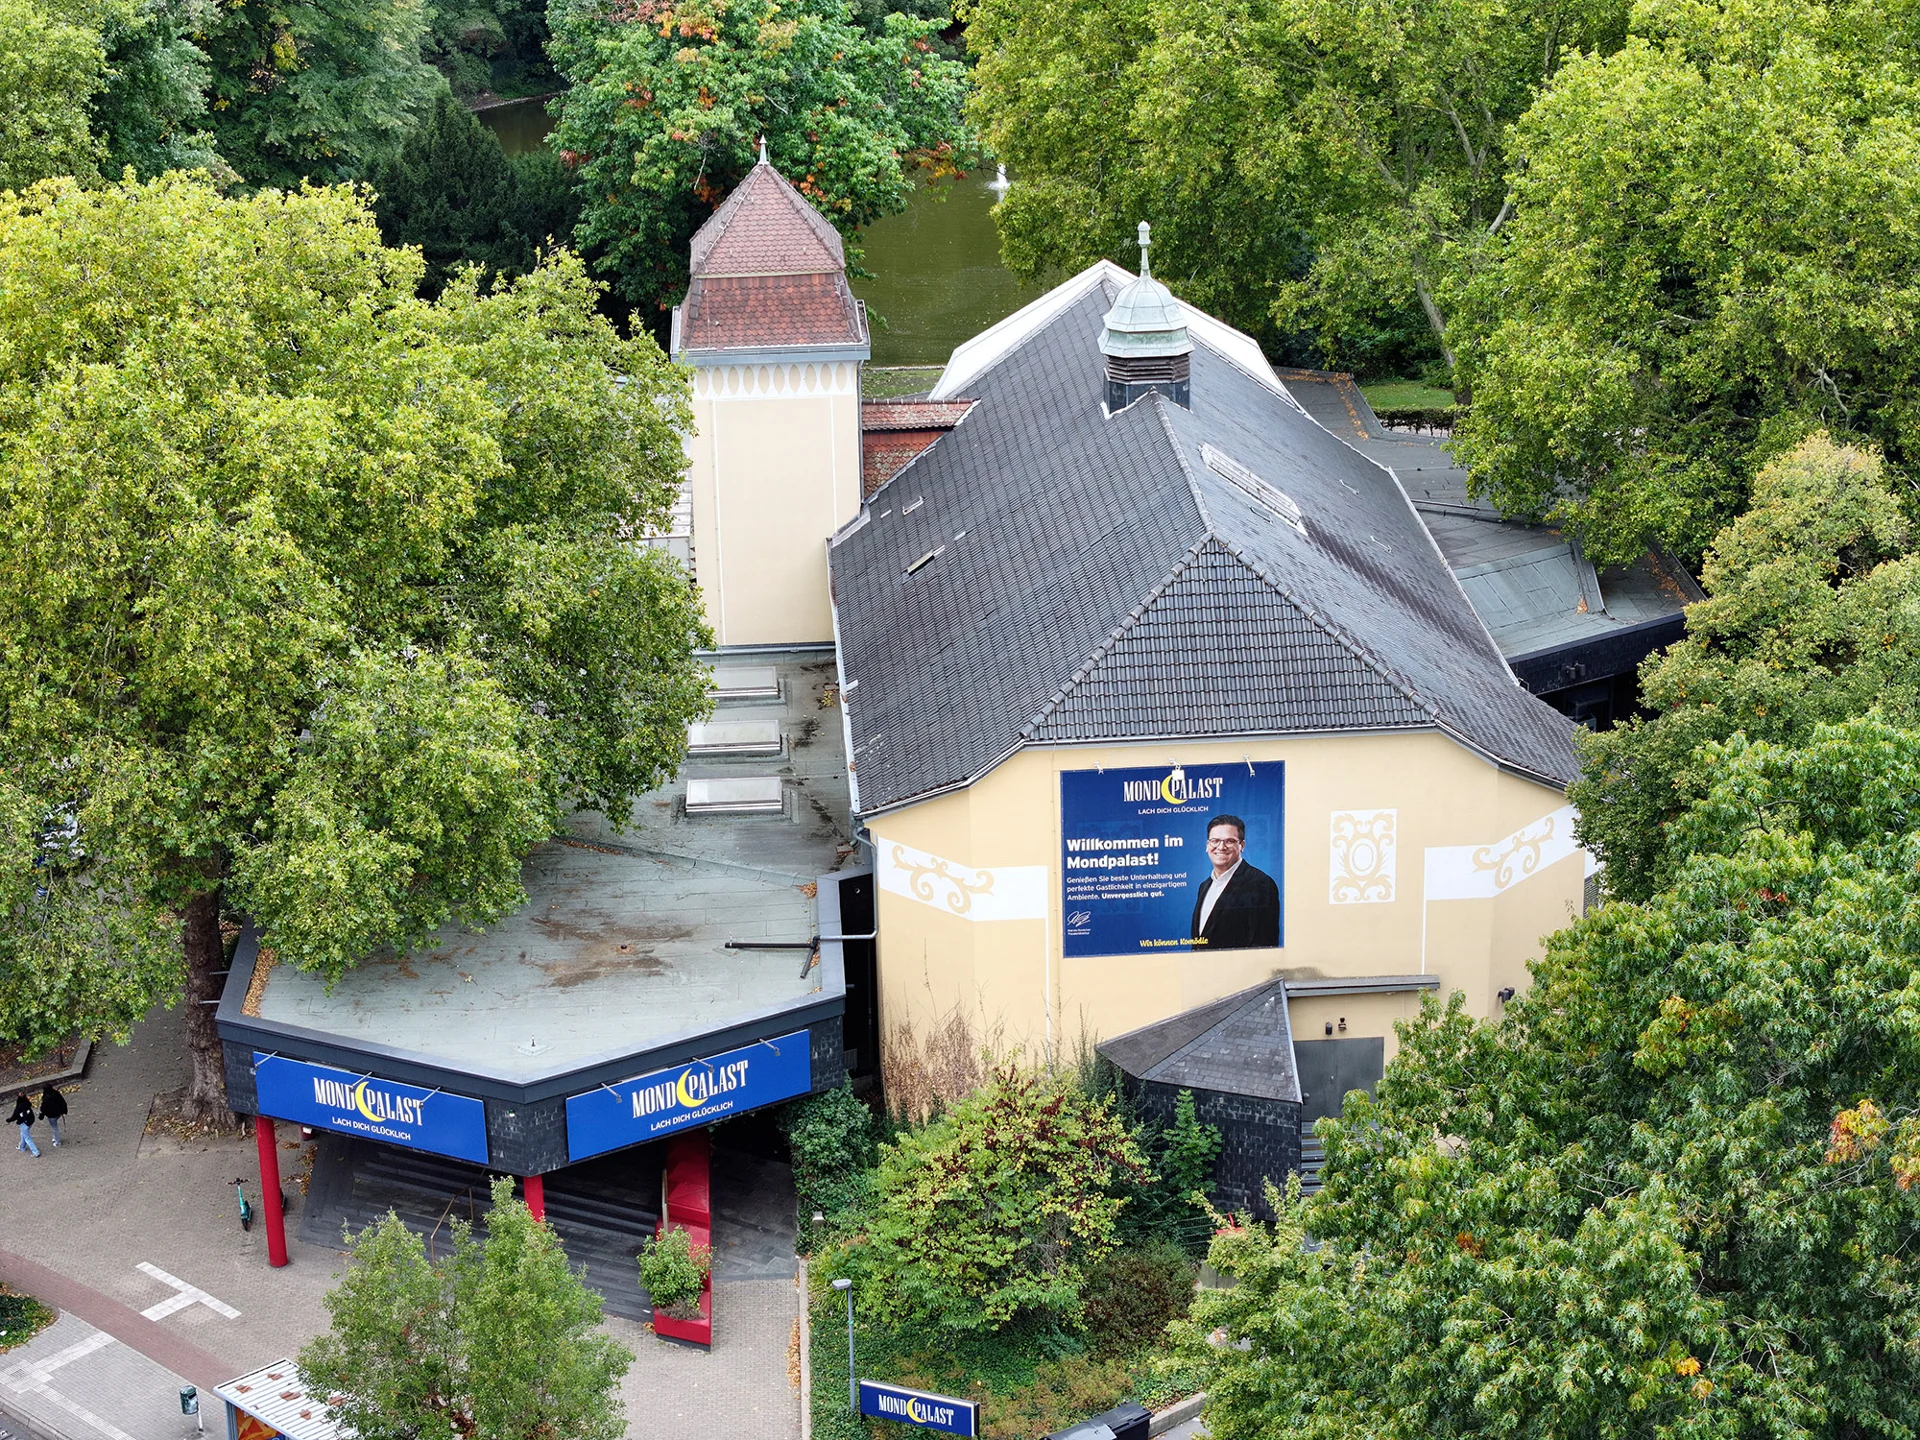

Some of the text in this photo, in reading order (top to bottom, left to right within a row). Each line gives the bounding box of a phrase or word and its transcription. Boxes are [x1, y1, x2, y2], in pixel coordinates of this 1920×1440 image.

[1123, 777, 1223, 802] MOND PALAST
[1173, 805, 1209, 813] GLÜCKLICH
[1066, 834, 1184, 852] Willkommen im
[1066, 852, 1159, 870] Mondpalast!
[1066, 876, 1098, 884] Genießen
[1130, 873, 1173, 881] Unterhaltung
[1066, 885, 1095, 893] perfekte
[1095, 883, 1134, 891] Gastlichkeit
[1143, 881, 1187, 889] einzigartigem
[1101, 891, 1149, 900] Unvergesslich
[1150, 890, 1165, 898] gut.
[1139, 936, 1209, 947] Wir können Komödie
[631, 1060, 749, 1119] MOND PALAST
[313, 1077, 423, 1126] MOND PALAST
[650, 1100, 734, 1131] LACH DICH GLÜCKLICH
[332, 1116, 411, 1140] LACH DICH GLÜCKLICH
[878, 1394, 954, 1426] MOND PALAST
